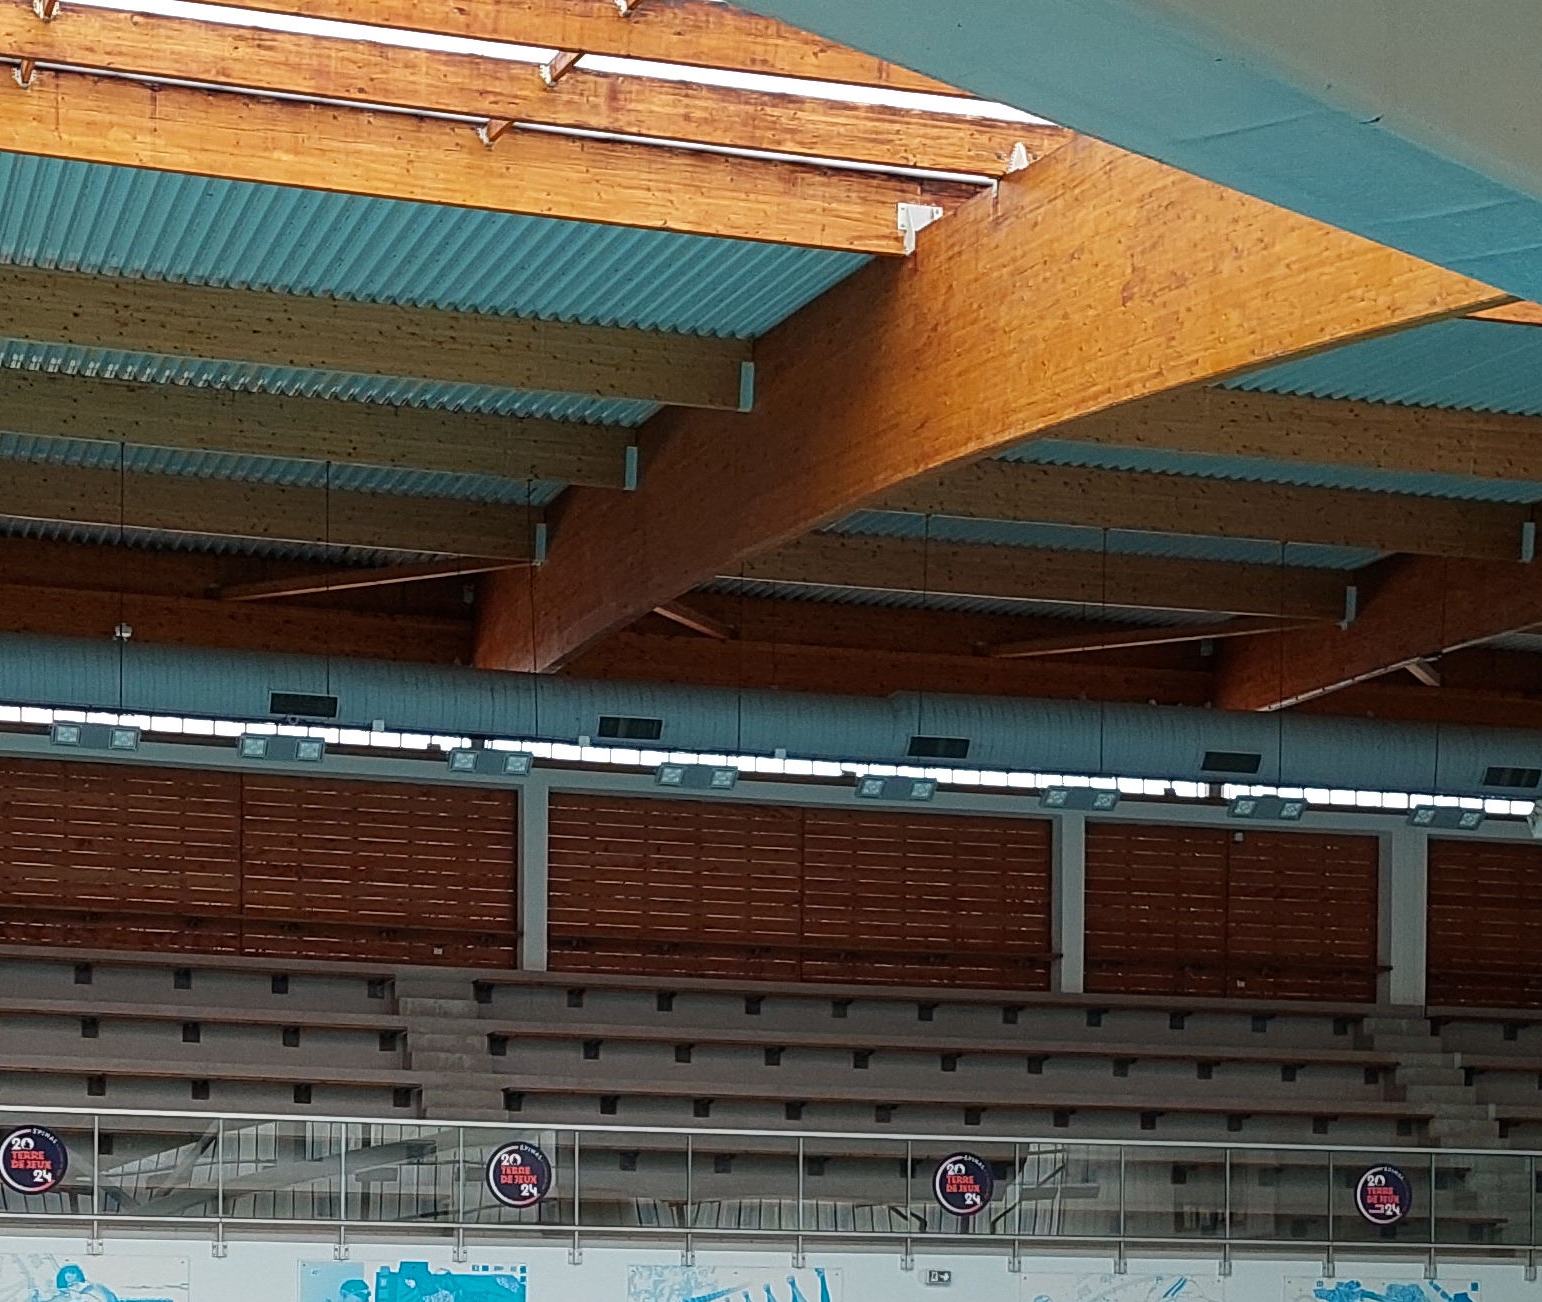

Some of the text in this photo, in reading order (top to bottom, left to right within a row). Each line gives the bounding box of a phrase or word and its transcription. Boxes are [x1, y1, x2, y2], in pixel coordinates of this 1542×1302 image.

[11, 1137, 34, 1150] 20
[11, 1151, 45, 1160] TERRE
[500, 1153, 521, 1165] 20
[11, 1161, 52, 1169] DE JEUX
[501, 1166, 531, 1174] TERRE
[946, 1163, 966, 1175] 20
[33, 1170, 52, 1182] 24
[500, 1175, 538, 1184] DE JEUX
[946, 1176, 974, 1184] TERRE
[1367, 1175, 1386, 1186] 20
[520, 1184, 538, 1196] 24
[946, 1184, 980, 1192] DE JEUX
[964, 1193, 981, 1205] 24
[1385, 1203, 1401, 1215] 24
